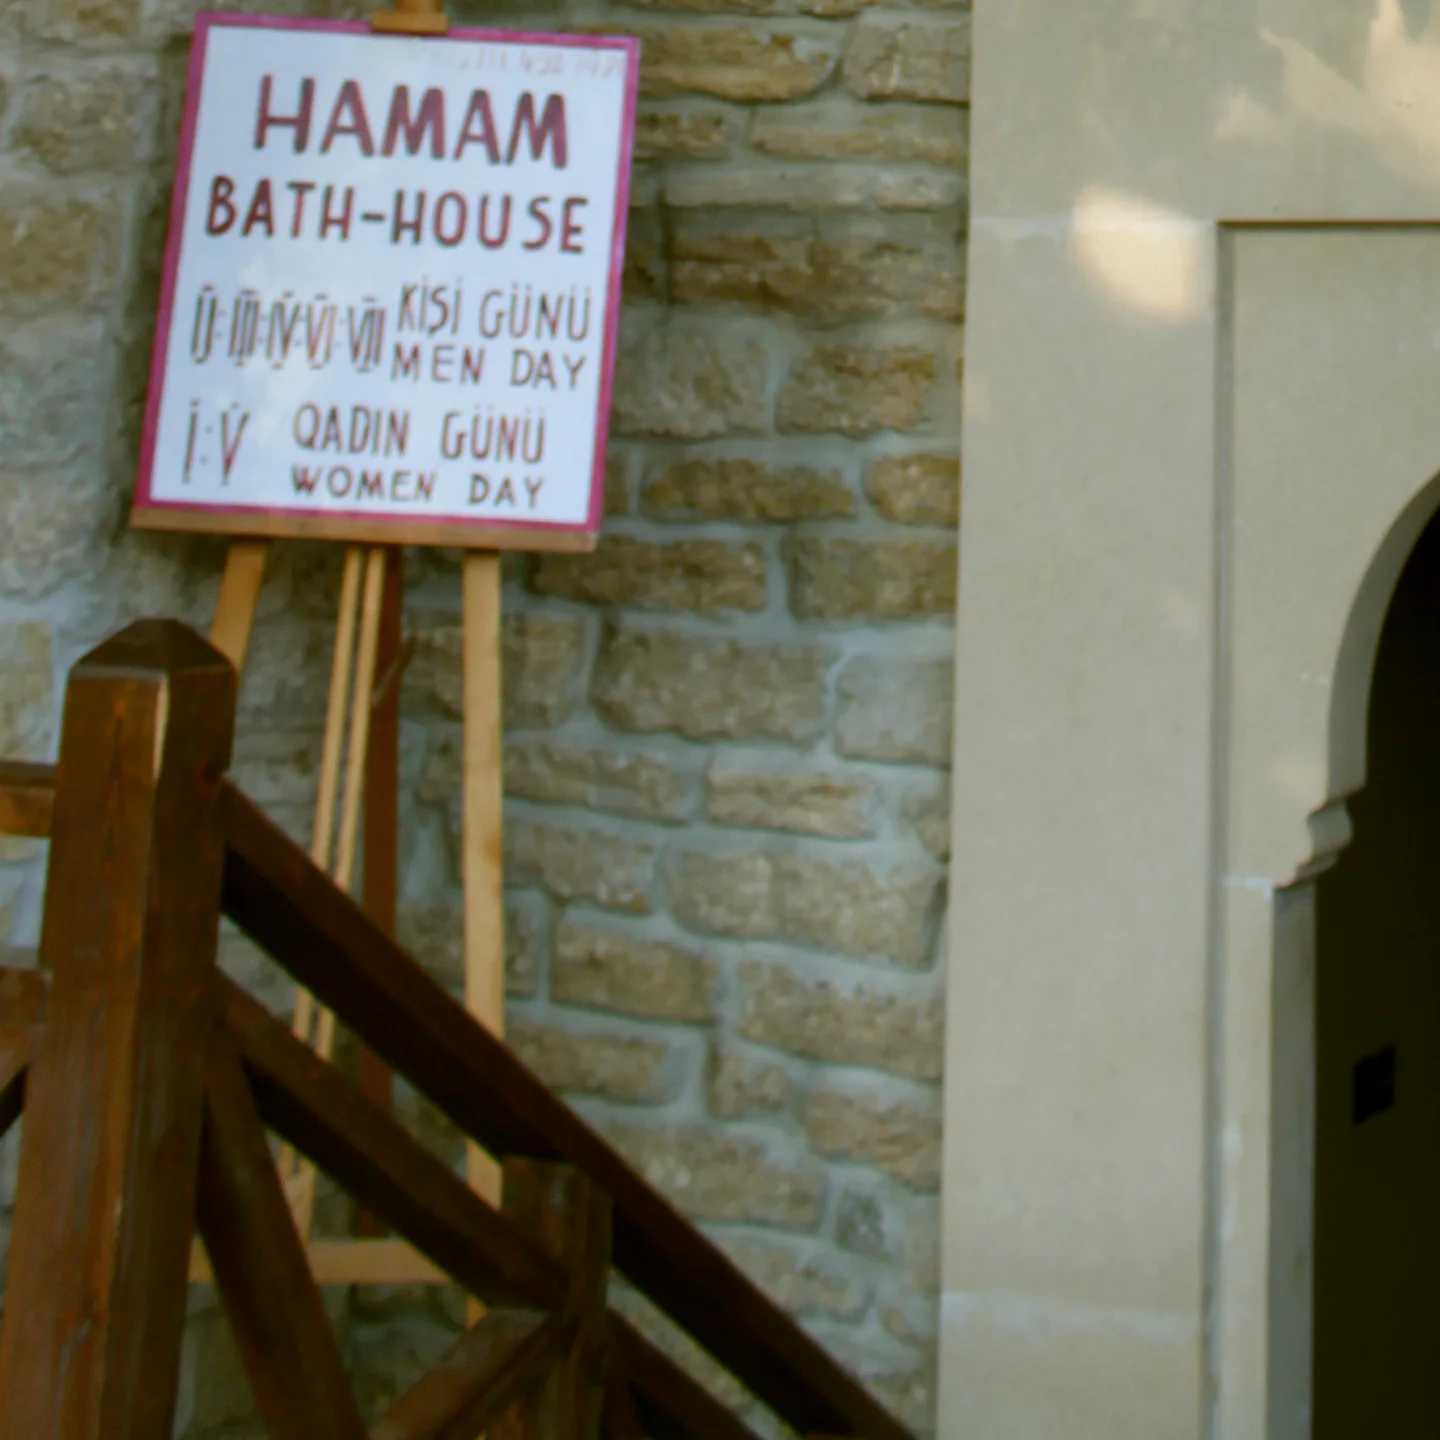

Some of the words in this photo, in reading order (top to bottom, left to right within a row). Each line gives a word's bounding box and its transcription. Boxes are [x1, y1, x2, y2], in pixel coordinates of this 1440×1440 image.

[253, 74, 568, 169] HAMAM
[205, 174, 590, 254] BATH-HOUSE
[479, 280, 593, 342] GÜNÜ
[391, 342, 486, 385] MEN
[510, 348, 588, 390] DAY
[292, 402, 411, 458] QADIN
[440, 404, 546, 464] GÜNÜ
[291, 465, 439, 503] WOMEN
[468, 473, 545, 509] DAY
